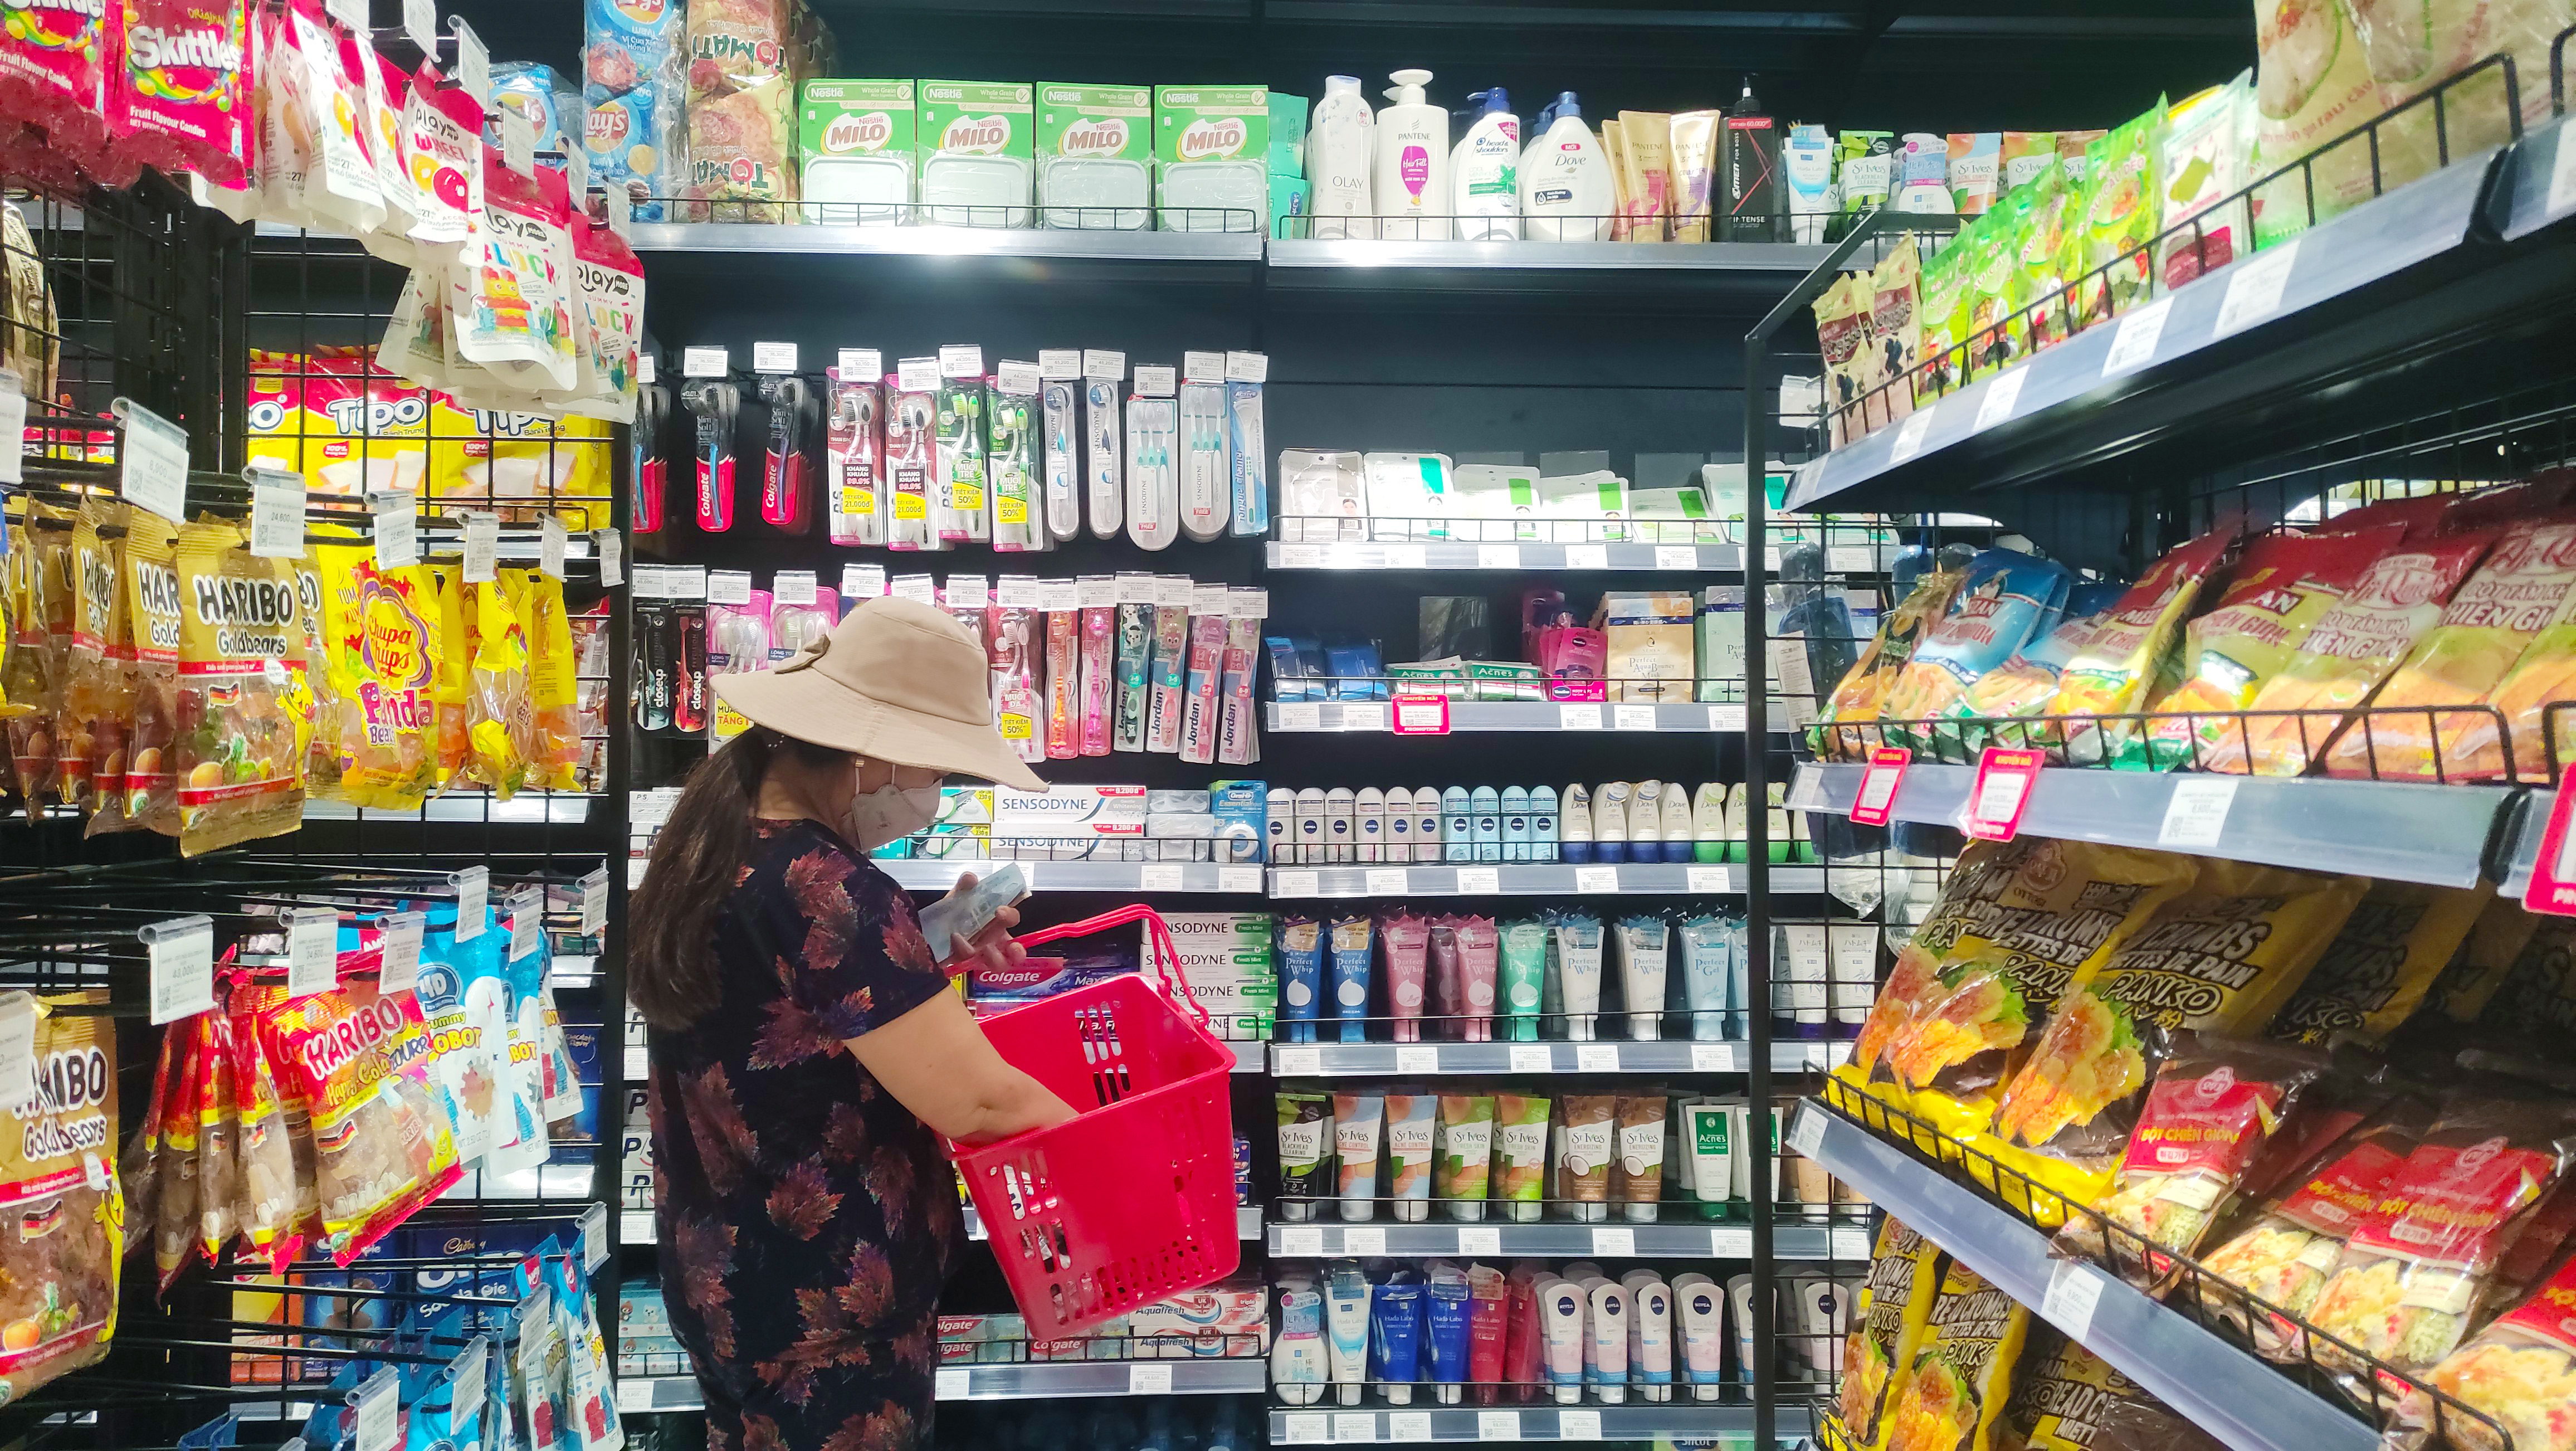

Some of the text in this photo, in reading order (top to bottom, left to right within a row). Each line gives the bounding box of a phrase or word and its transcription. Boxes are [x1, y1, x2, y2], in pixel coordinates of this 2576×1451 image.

[129, 26, 241, 74] Skittles
[21, 57, 46, 78] Flavour
[47, 69, 72, 90] Candies
[130, 106, 152, 120] Fruit
[152, 110, 179, 129] Flavour
[180, 119, 206, 138] Candies
[831, 124, 886, 145] MILO
[949, 128, 1003, 148] MILO
[1068, 130, 1121, 149] MILO
[1186, 130, 1240, 151] MILO
[1555, 154, 1587, 166] Dove
[1333, 176, 1364, 189] OLAY
[496, 235, 529, 250] GUMMY
[587, 295, 613, 305] GUMMY
[766, 464, 777, 508] Colgate
[1235, 449, 1245, 523] Tongue Cleaner
[196, 576, 294, 625] HARIBO
[336, 586, 358, 604] YUM
[2443, 601, 2516, 627] HIÊN
[368, 615, 412, 646] Chupa
[218, 630, 285, 656] Goldbears
[371, 639, 410, 668] Chups
[1629, 658, 1656, 667] Perfect
[1479, 668, 1513, 678] Acnes
[654, 669, 667, 708] closeup
[691, 671, 704, 710] closeup
[361, 683, 435, 729] Pnda
[718, 714, 743, 727] TẶNG
[1187, 703, 1200, 746] Jordan
[1228, 703, 1236, 747] Jordan
[1003, 798, 1088, 810] SENSODYNE
[999, 836, 1085, 847] SENSODYNE
[2057, 944, 2089, 966] DE
[1286, 957, 1313, 969] Perfect
[1291, 965, 1314, 975] Whip
[1336, 958, 1366, 970] Perfect
[1341, 965, 1367, 975] Whip
[1393, 957, 1423, 969] Perfect
[1399, 965, 1423, 975] Whip
[1466, 957, 1495, 969] Perfect
[1472, 965, 1495, 975] Whip
[1568, 958, 1598, 968] Perfect
[1575, 965, 1598, 974] Whip
[1633, 958, 1663, 968] Perfect
[1641, 965, 1664, 974] Whip
[1695, 958, 1725, 970] Perfect
[980, 971, 1040, 983] Colgate
[1704, 966, 1719, 976] Gel
[2163, 953, 2258, 989] DE PAIN
[2100, 972, 2222, 1015] PANKO
[426, 1012, 466, 1029] ummy
[305, 997, 402, 1078] HARIBO
[434, 1029, 481, 1053] OBOT
[24, 1117, 106, 1159] Goldbears
[1699, 1134, 1726, 1143] Acnes
[1136, 1305, 1184, 1315] Aquafresh
[938, 1321, 972, 1333] olgate
[941, 1341, 972, 1353] lgate
[1033, 1339, 1080, 1350] Colgate
[1140, 1337, 1189, 1348] Aquafresh
[1940, 1341, 1998, 1366] PANK
